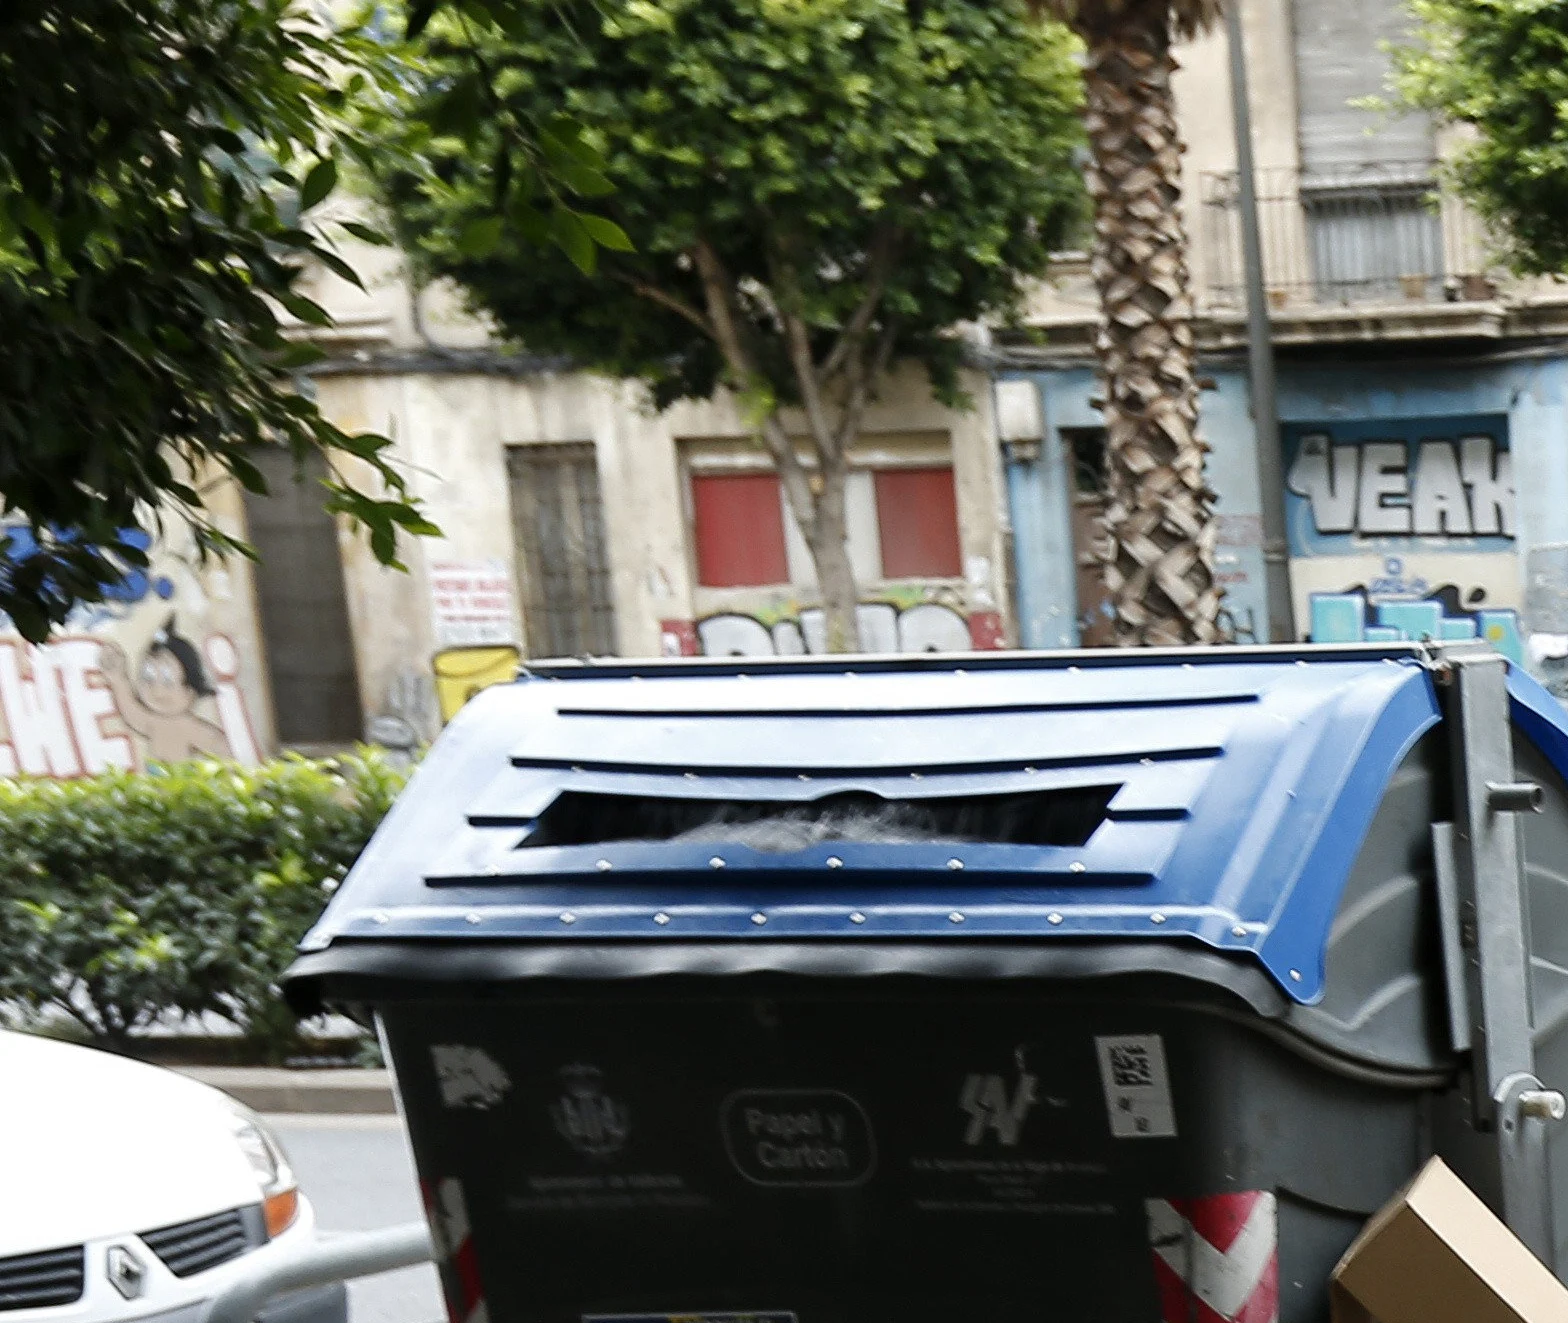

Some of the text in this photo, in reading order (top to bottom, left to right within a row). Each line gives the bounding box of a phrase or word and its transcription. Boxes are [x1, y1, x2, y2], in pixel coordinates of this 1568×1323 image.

[744, 1107, 847, 1144] Papel y
[756, 1140, 850, 1170] Cartón
